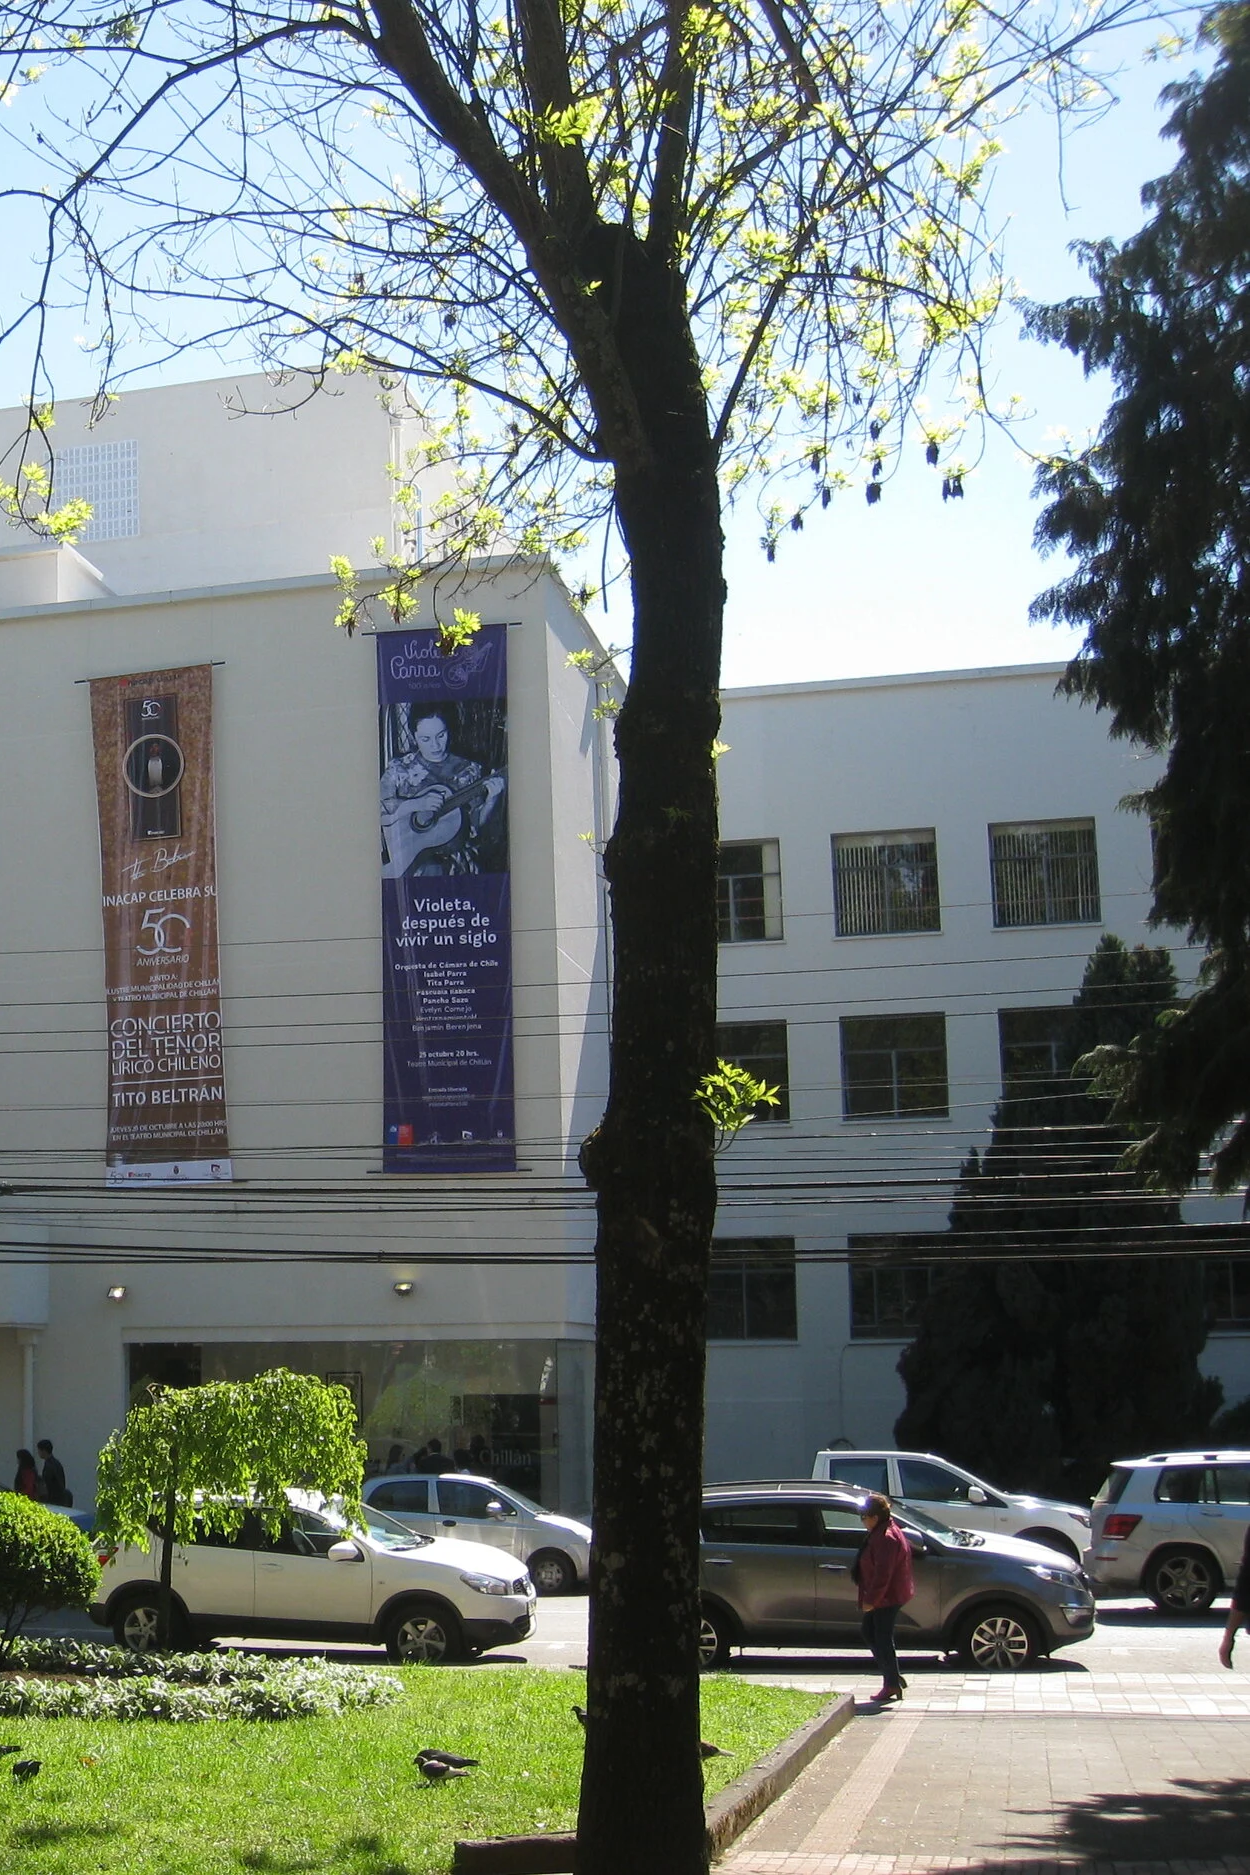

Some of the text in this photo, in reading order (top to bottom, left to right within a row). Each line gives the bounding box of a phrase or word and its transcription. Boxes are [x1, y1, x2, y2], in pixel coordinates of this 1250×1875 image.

[103, 892, 147, 907] INACAP
[149, 886, 202, 903] CELEBRA
[414, 898, 476, 913] Violeta,
[136, 907, 191, 956] 50
[402, 912, 490, 933] después de
[395, 929, 497, 948] vivir un siglo
[136, 953, 190, 967] ANIVERSARIO
[394, 962, 426, 972] Orquesta
[428, 961, 437, 969] de
[469, 959, 479, 968] de
[480, 958, 499, 967] Chile
[423, 970, 446, 978] Isabel
[427, 979, 443, 987] Tita
[110, 1011, 221, 1039] CONCIERTO
[112, 1032, 221, 1061] DEL TENOR
[157, 1054, 221, 1072] CHILENO
[112, 1084, 223, 1108] TITO BELTRÁN
[152, 1130, 187, 1139] MUNICIPAL
